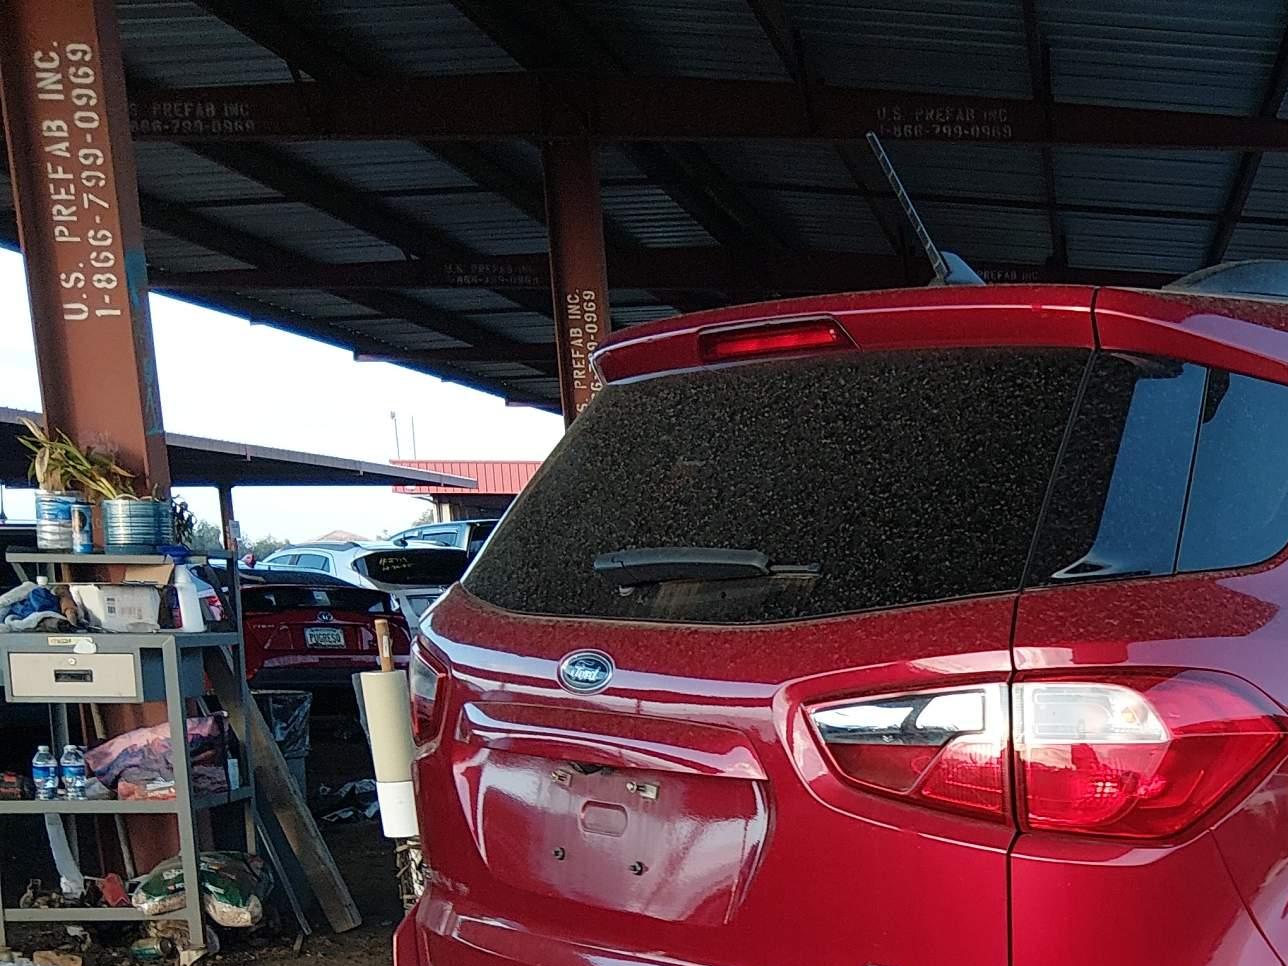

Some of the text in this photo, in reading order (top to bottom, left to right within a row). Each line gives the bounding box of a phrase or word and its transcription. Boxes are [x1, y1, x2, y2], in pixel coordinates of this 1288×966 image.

[34, 41, 89, 321] U.S. PREFAB INC.
[66, 43, 121, 318] 1-866-799-0969
[567, 289, 581, 319] INC.
[570, 328, 587, 390] PREFAB
[571, 659, 602, 682] Ford
